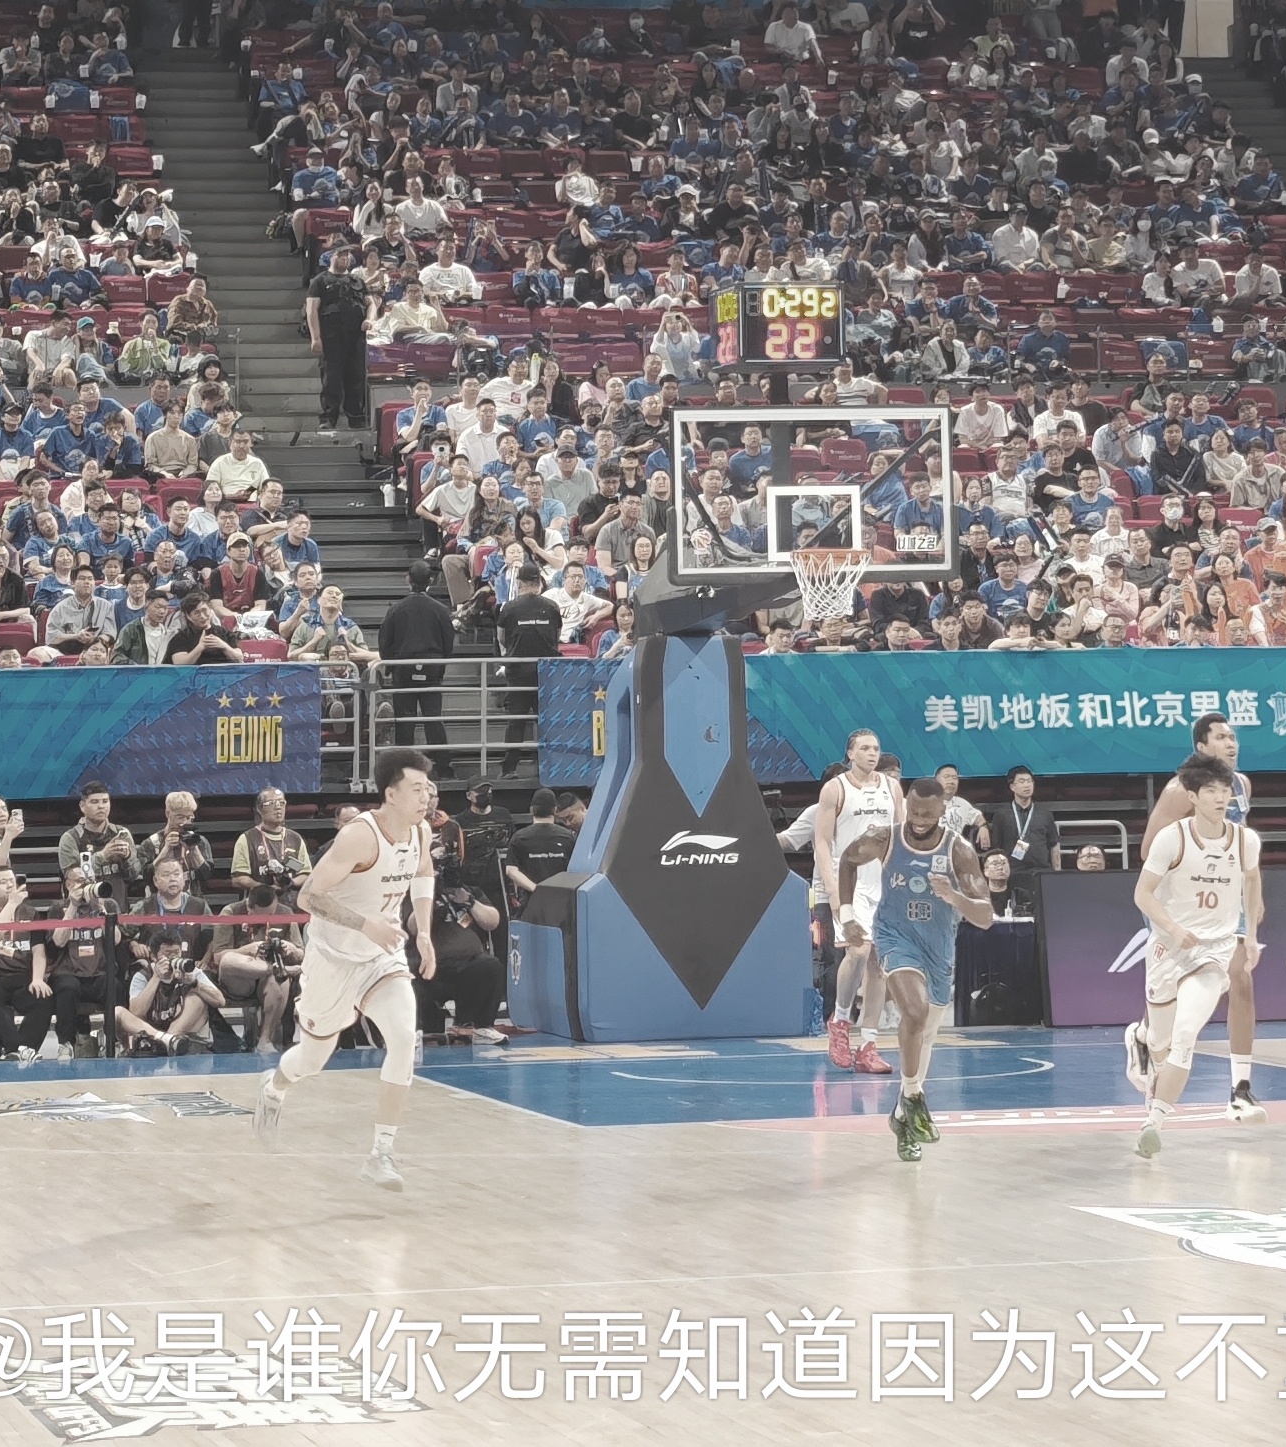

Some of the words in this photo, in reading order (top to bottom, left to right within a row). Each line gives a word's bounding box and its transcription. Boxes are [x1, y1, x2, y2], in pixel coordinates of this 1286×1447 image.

[766, 323, 817, 359] 22
[216, 715, 283, 764] BEIJING
[660, 851, 740, 867] LI-NING
[382, 893, 407, 913] 77
[1195, 891, 1219, 909] 10
